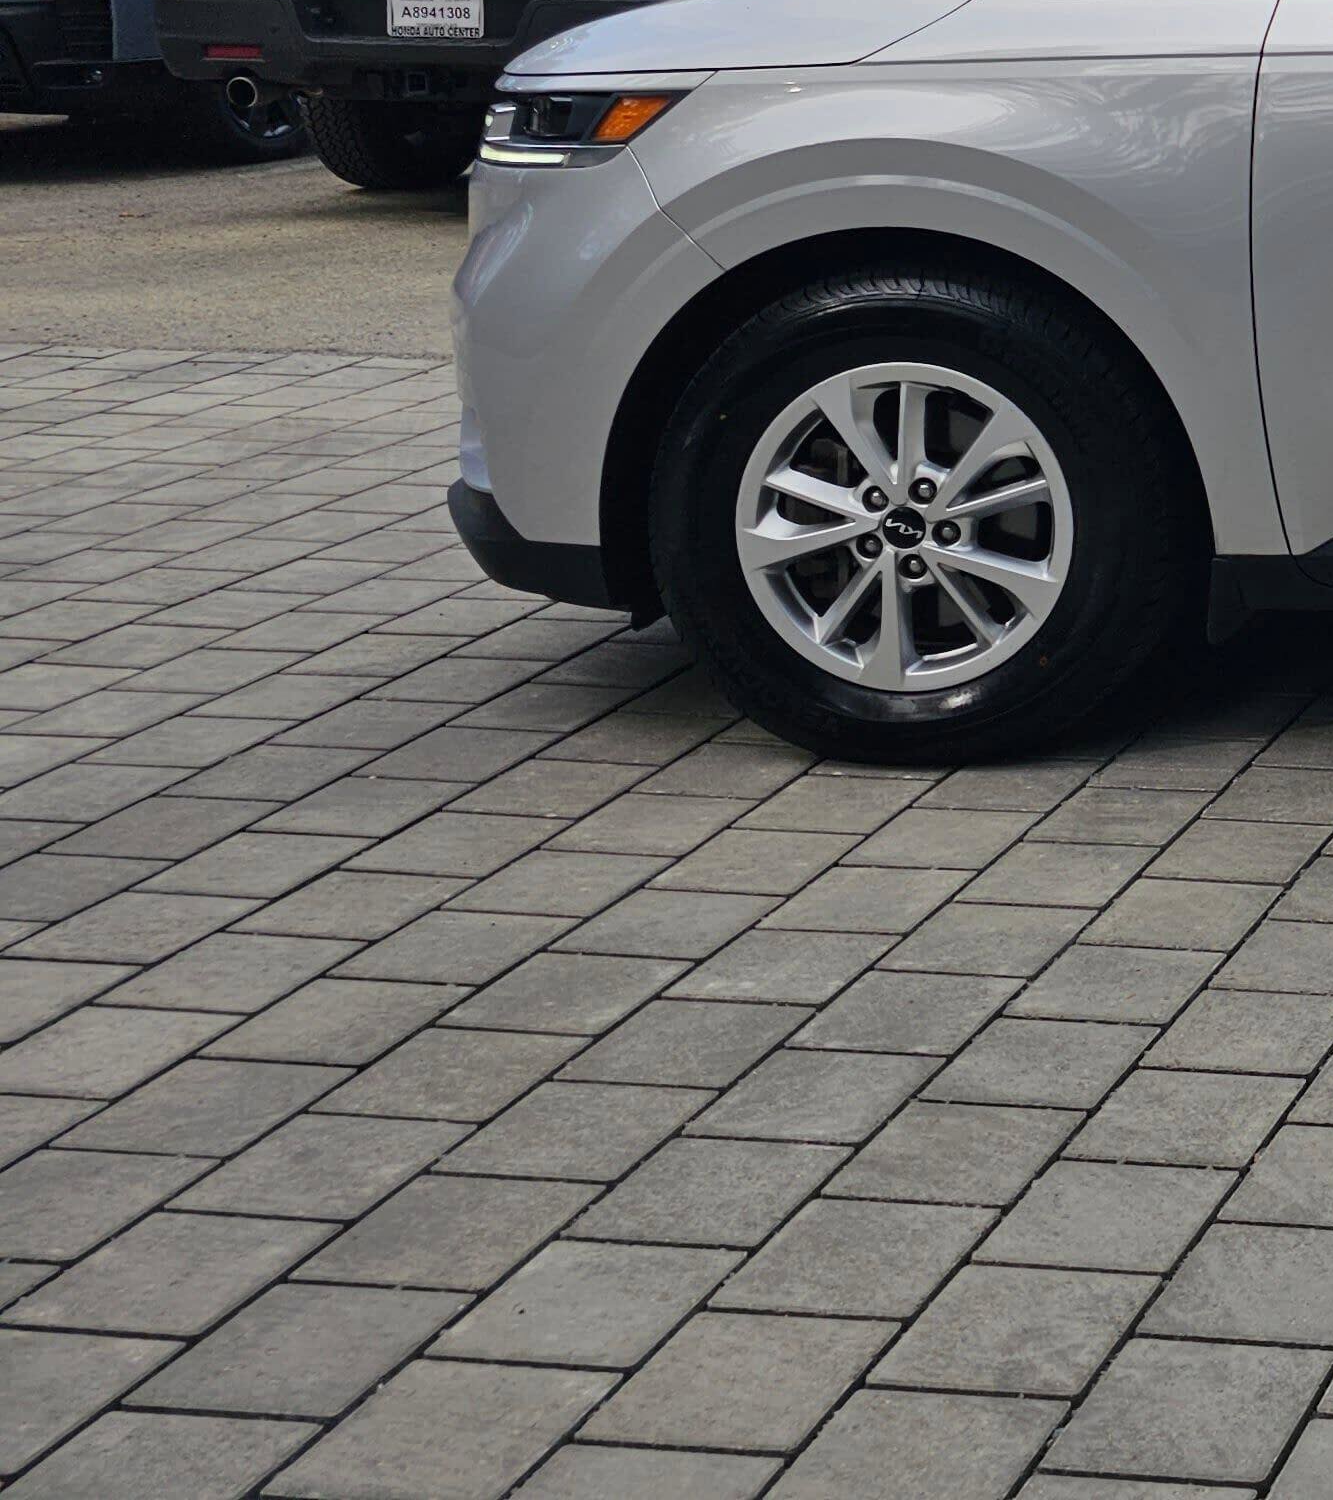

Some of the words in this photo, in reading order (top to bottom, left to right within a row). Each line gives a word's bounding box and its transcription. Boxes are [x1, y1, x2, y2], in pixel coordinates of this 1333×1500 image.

[402, 7, 471, 19] A8941308
[392, 26, 420, 36] HONDA
[424, 26, 445, 36] AUTO
[448, 27, 480, 37] CENTER
